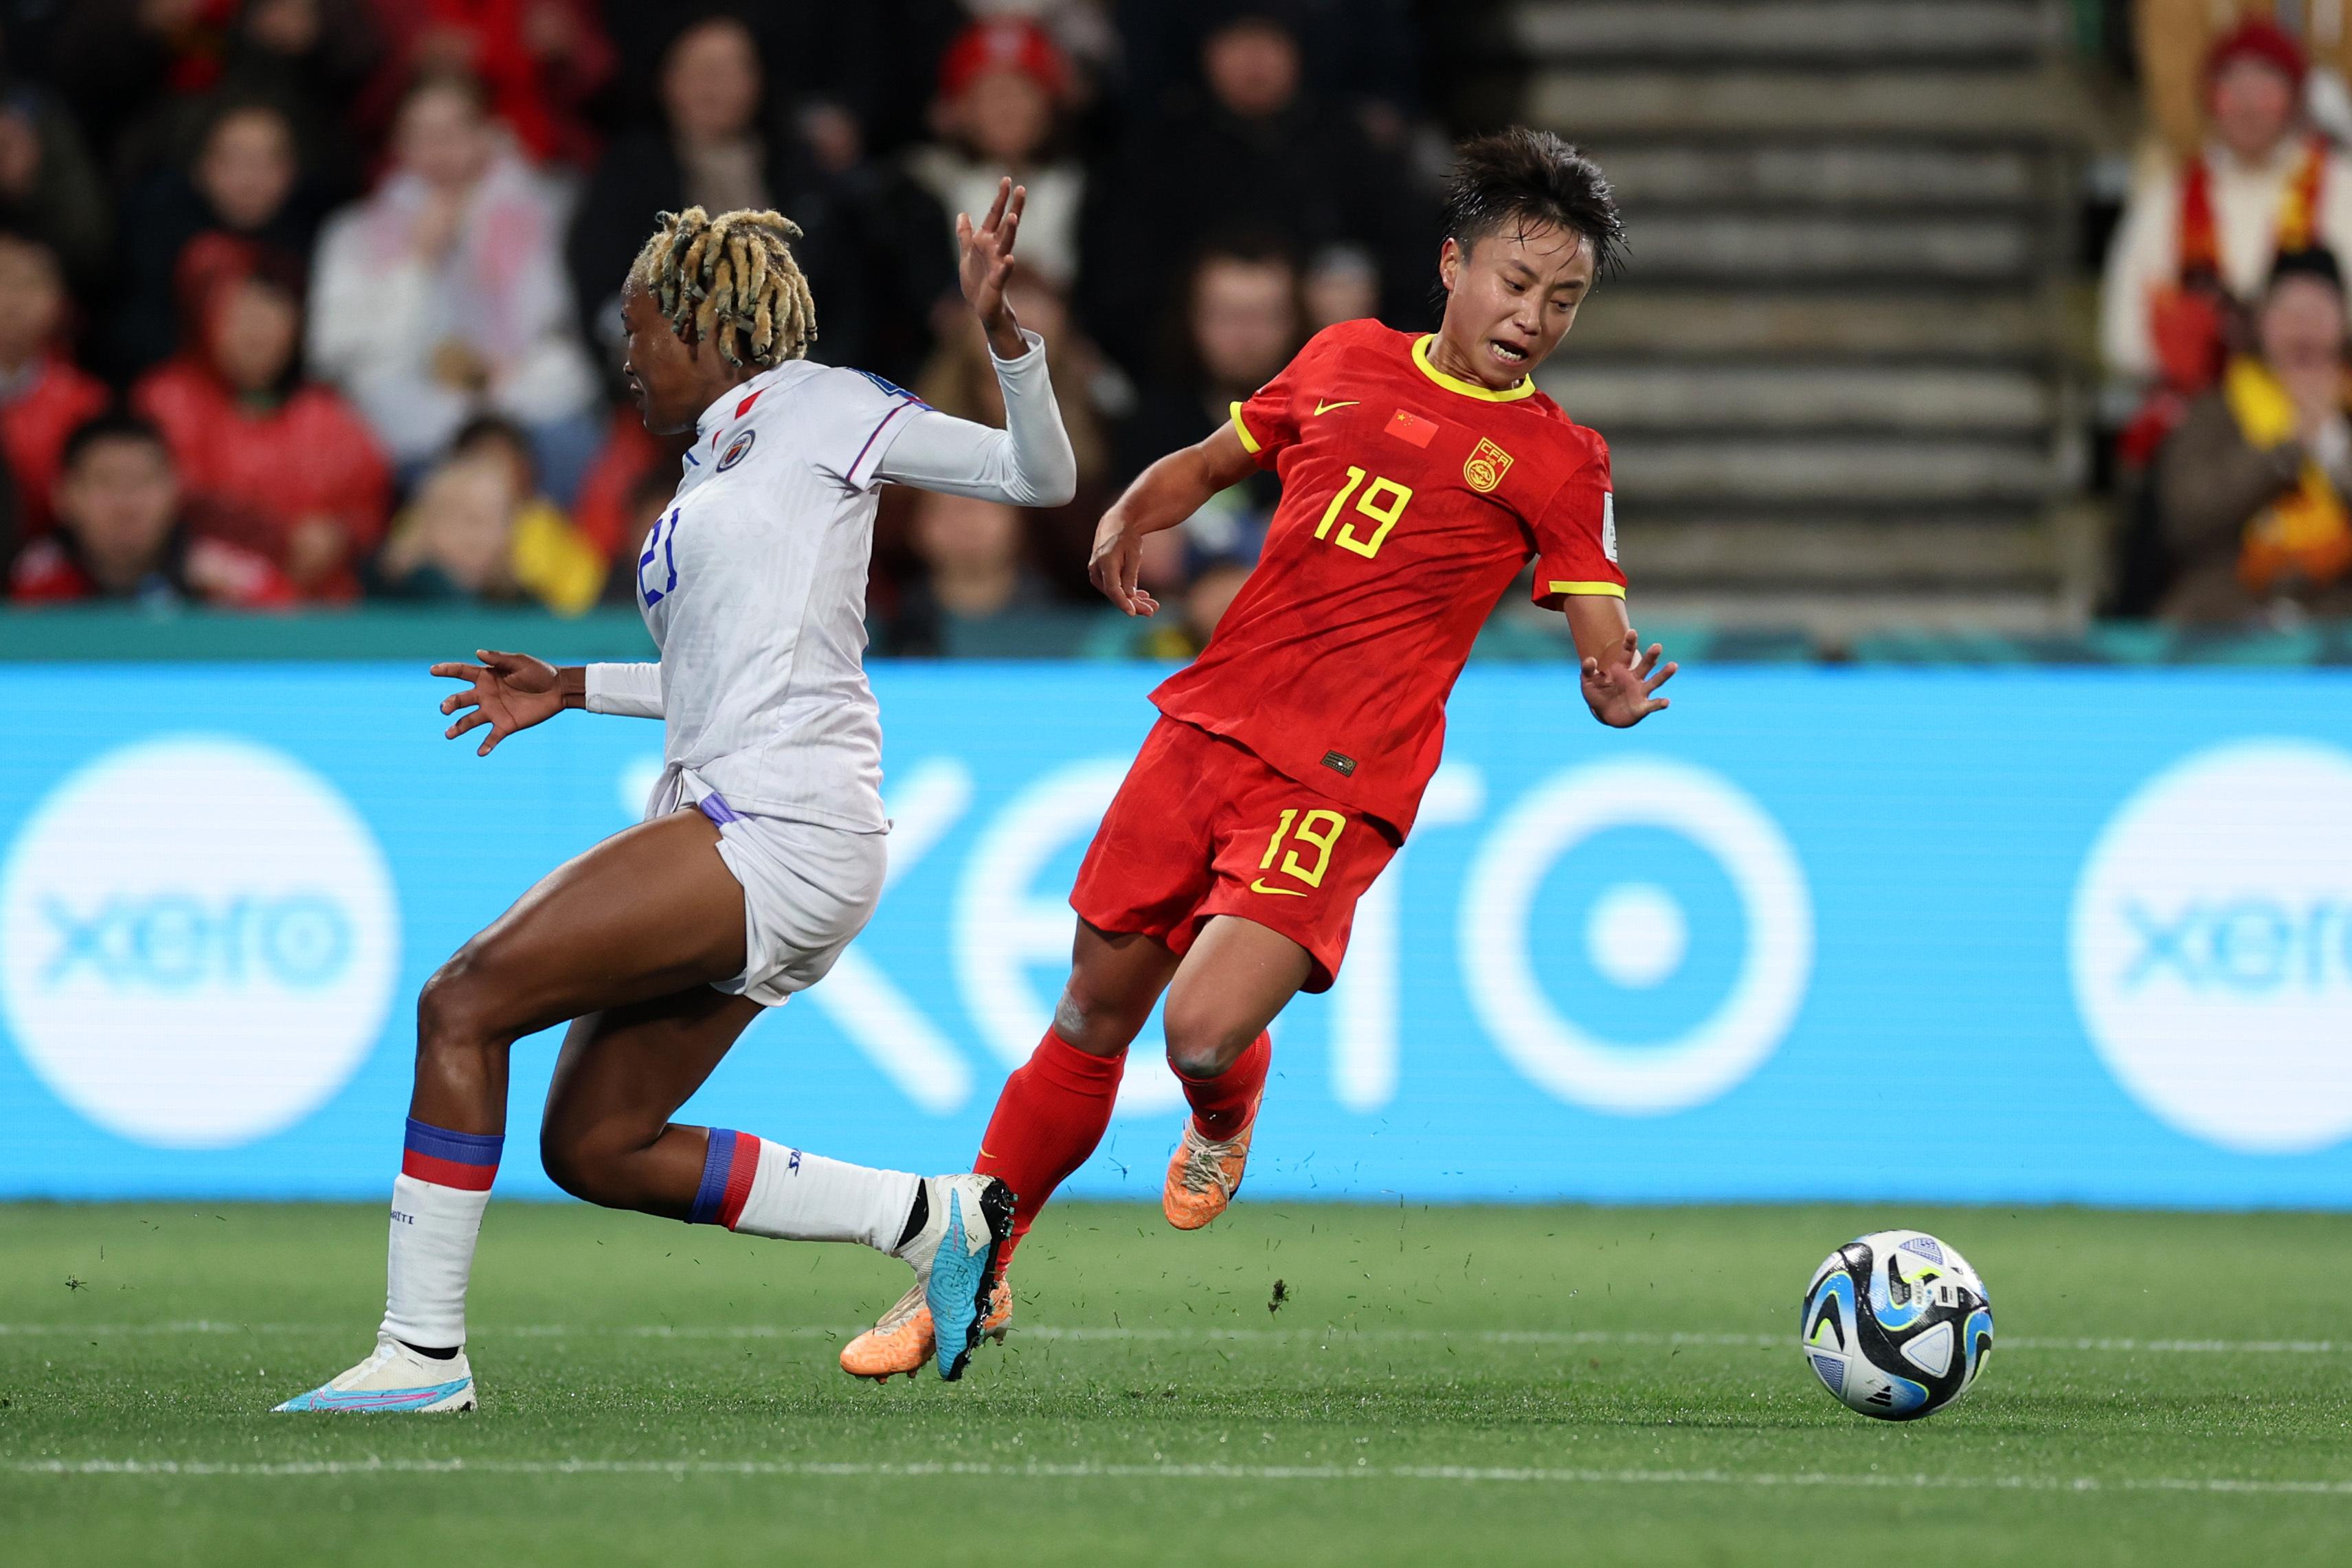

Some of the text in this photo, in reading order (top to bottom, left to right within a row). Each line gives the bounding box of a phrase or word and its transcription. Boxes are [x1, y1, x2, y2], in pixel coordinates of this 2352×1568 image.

[1480, 442, 1510, 467] CFA
[638, 507, 682, 609] 21
[1314, 465, 1413, 559] 19
[1258, 808, 1347, 888] 19
[36, 889, 356, 992] xero
[2116, 892, 2352, 996] xer
